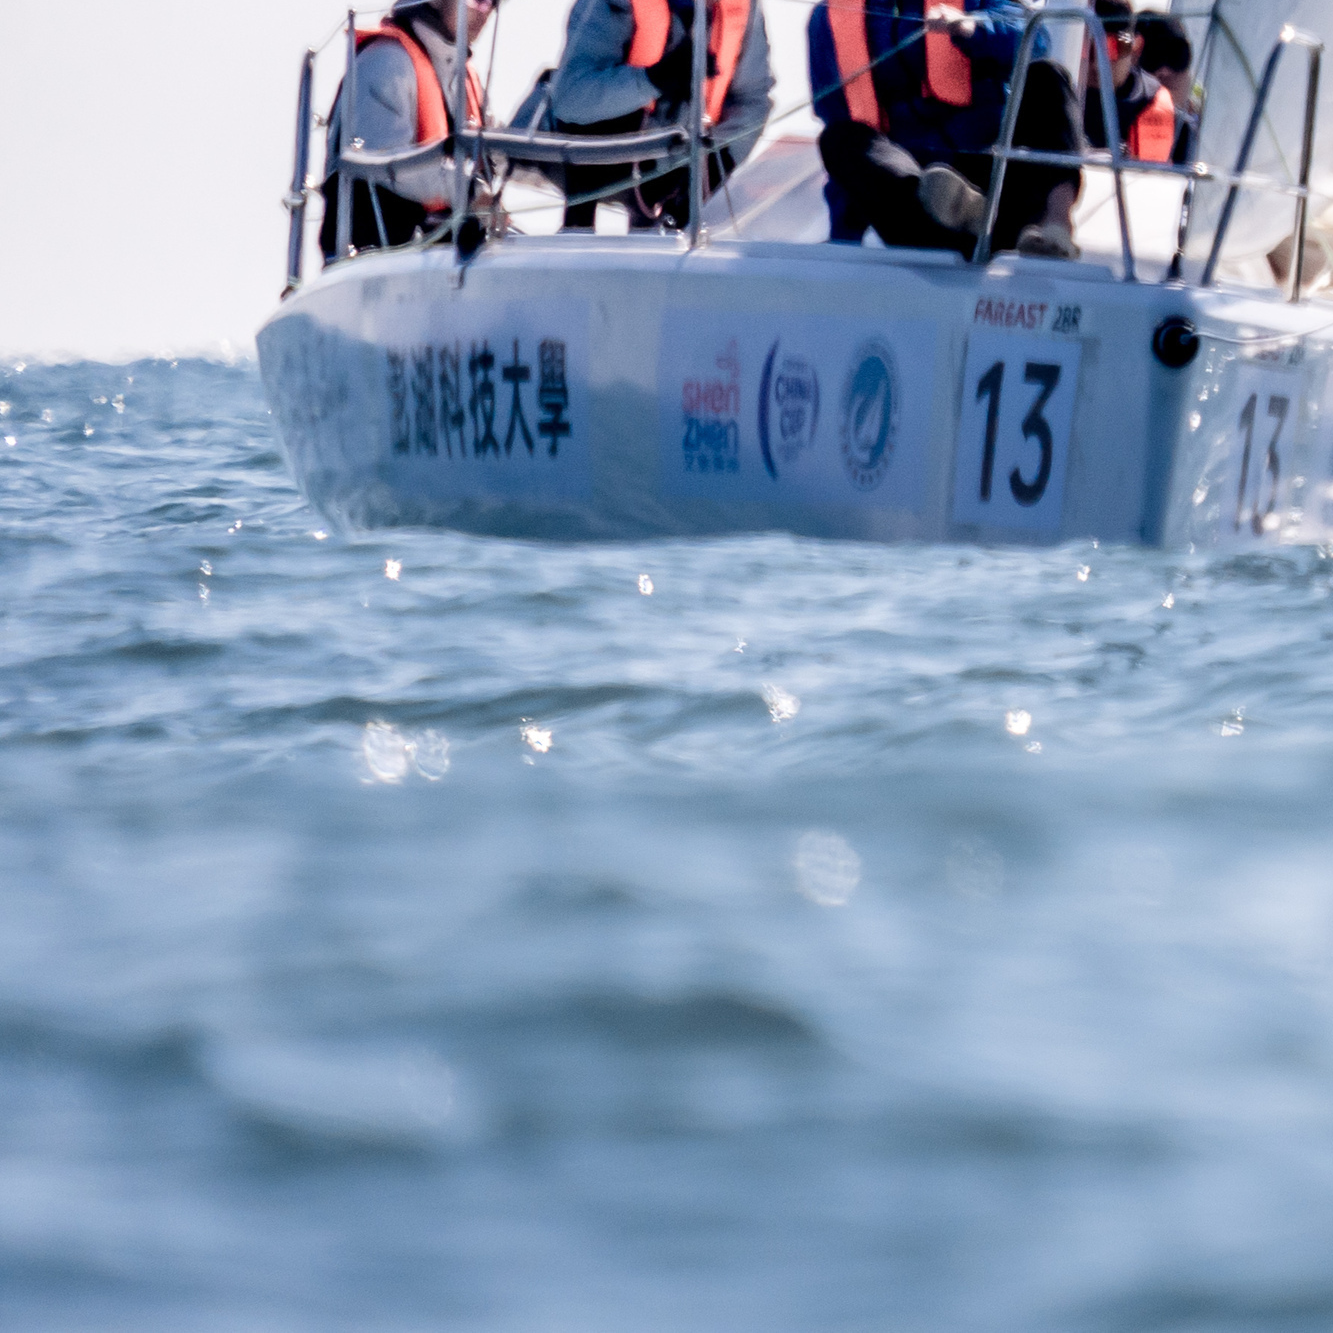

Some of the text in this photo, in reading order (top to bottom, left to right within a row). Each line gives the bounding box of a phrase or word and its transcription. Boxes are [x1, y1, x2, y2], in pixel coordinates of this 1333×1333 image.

[974, 297, 1049, 330] FAREAST
[975, 359, 1062, 508] 13
[1237, 392, 1291, 538] 13
